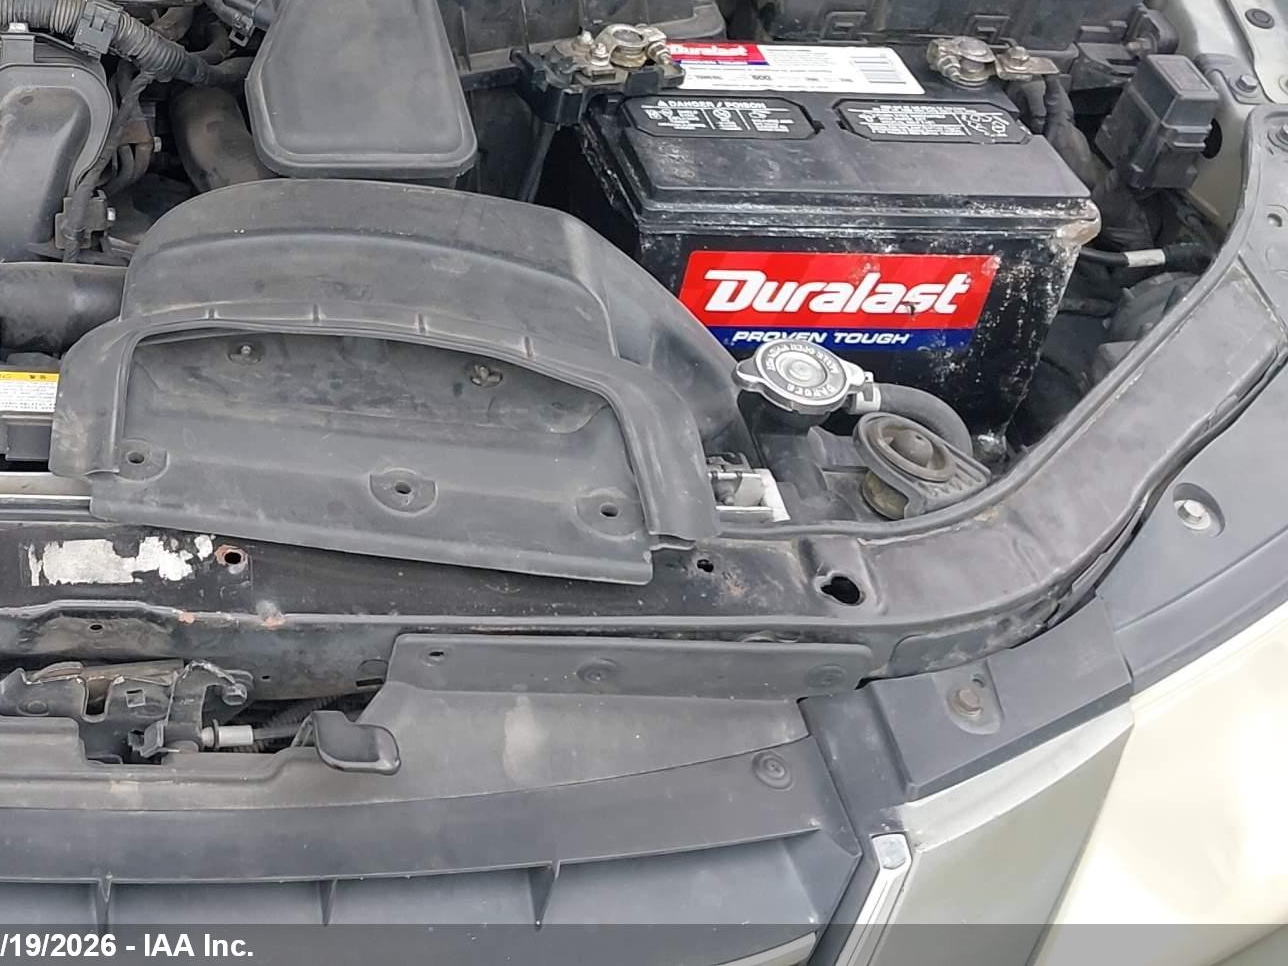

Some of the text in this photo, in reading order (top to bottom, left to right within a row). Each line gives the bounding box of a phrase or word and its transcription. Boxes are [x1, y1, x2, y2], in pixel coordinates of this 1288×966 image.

[724, 101, 767, 109] POISON
[704, 269, 970, 314] Duralast
[732, 331, 910, 344] PROVEN TOUGH
[786, 383, 836, 397] DANGER
